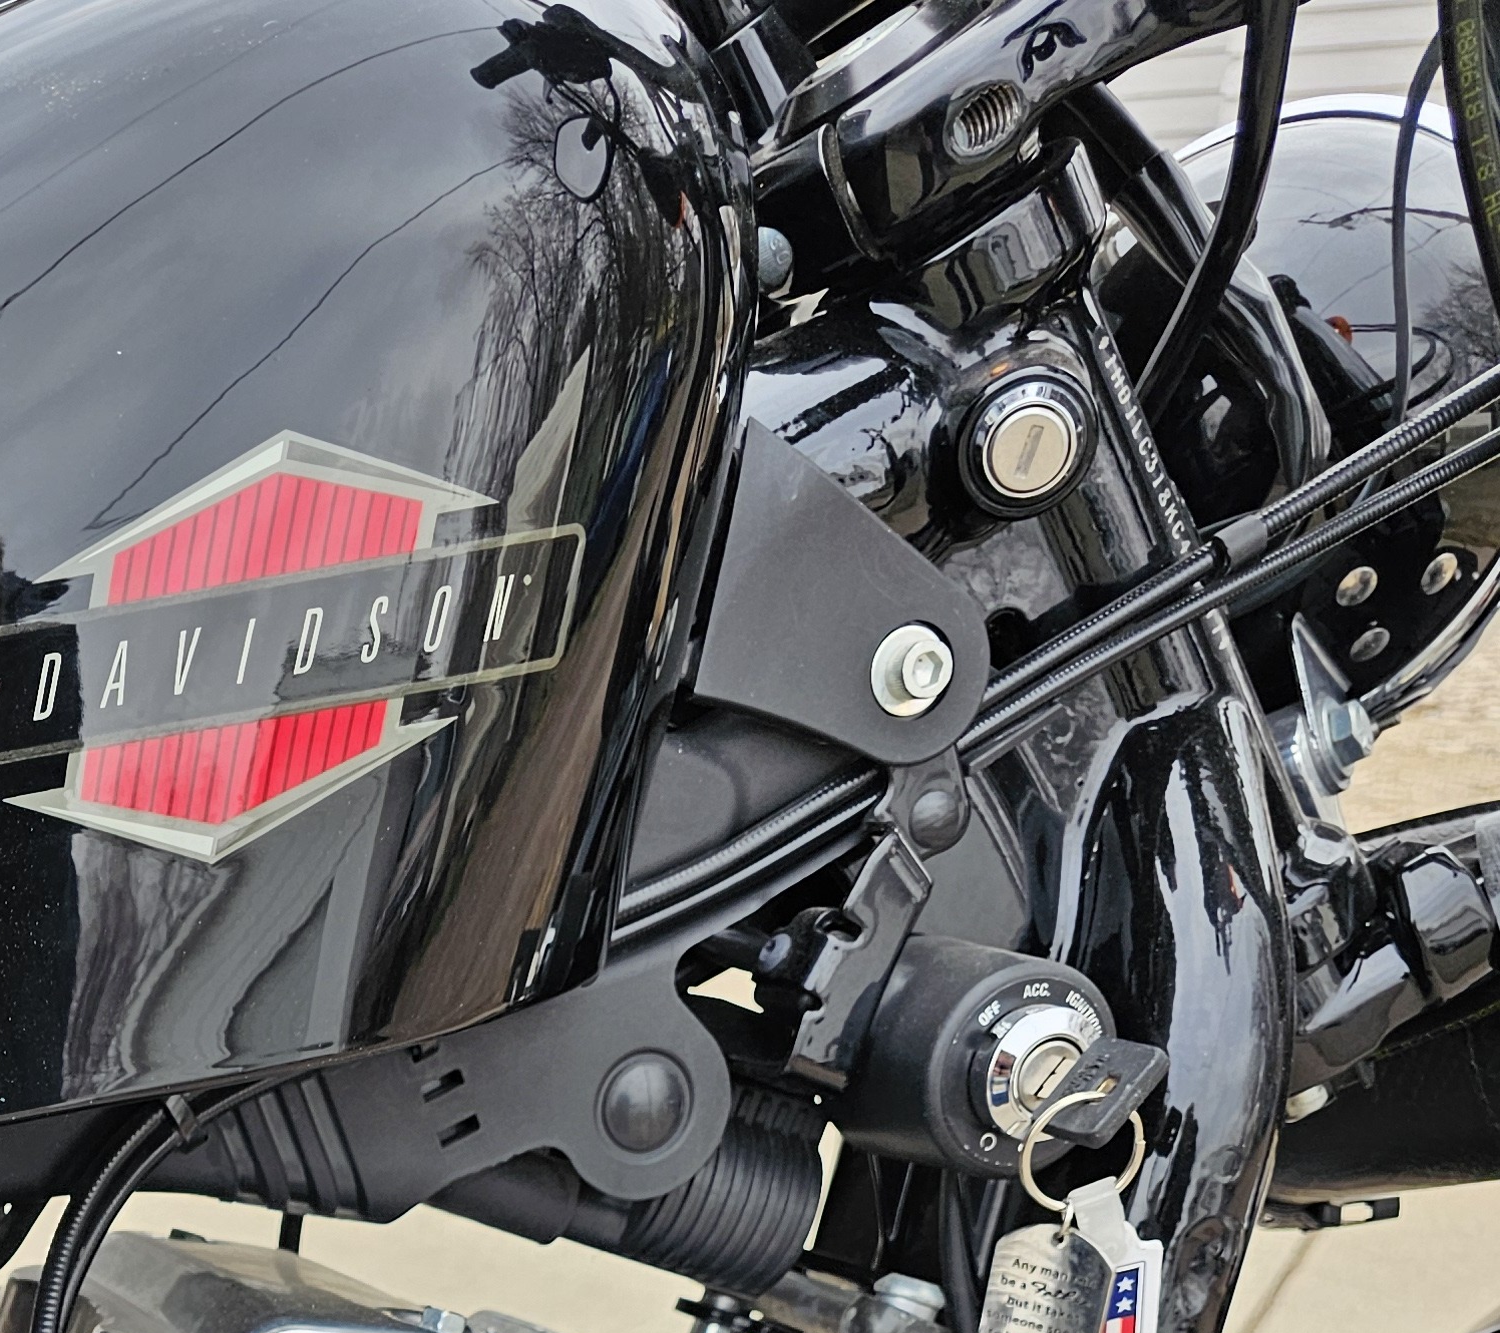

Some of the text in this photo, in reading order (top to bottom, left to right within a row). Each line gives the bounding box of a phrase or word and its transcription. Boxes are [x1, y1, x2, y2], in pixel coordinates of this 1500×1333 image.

[978, 1000, 1001, 1027] OFF
[1012, 1259, 1037, 1274] Any
[1041, 1266, 1068, 1281] man
[1001, 1275, 1016, 1287] be
[1020, 1282, 1027, 1290] a
[1006, 1296, 1029, 1311] but
[1031, 1301, 1041, 1312] it
[987, 1309, 1044, 1332] someone
